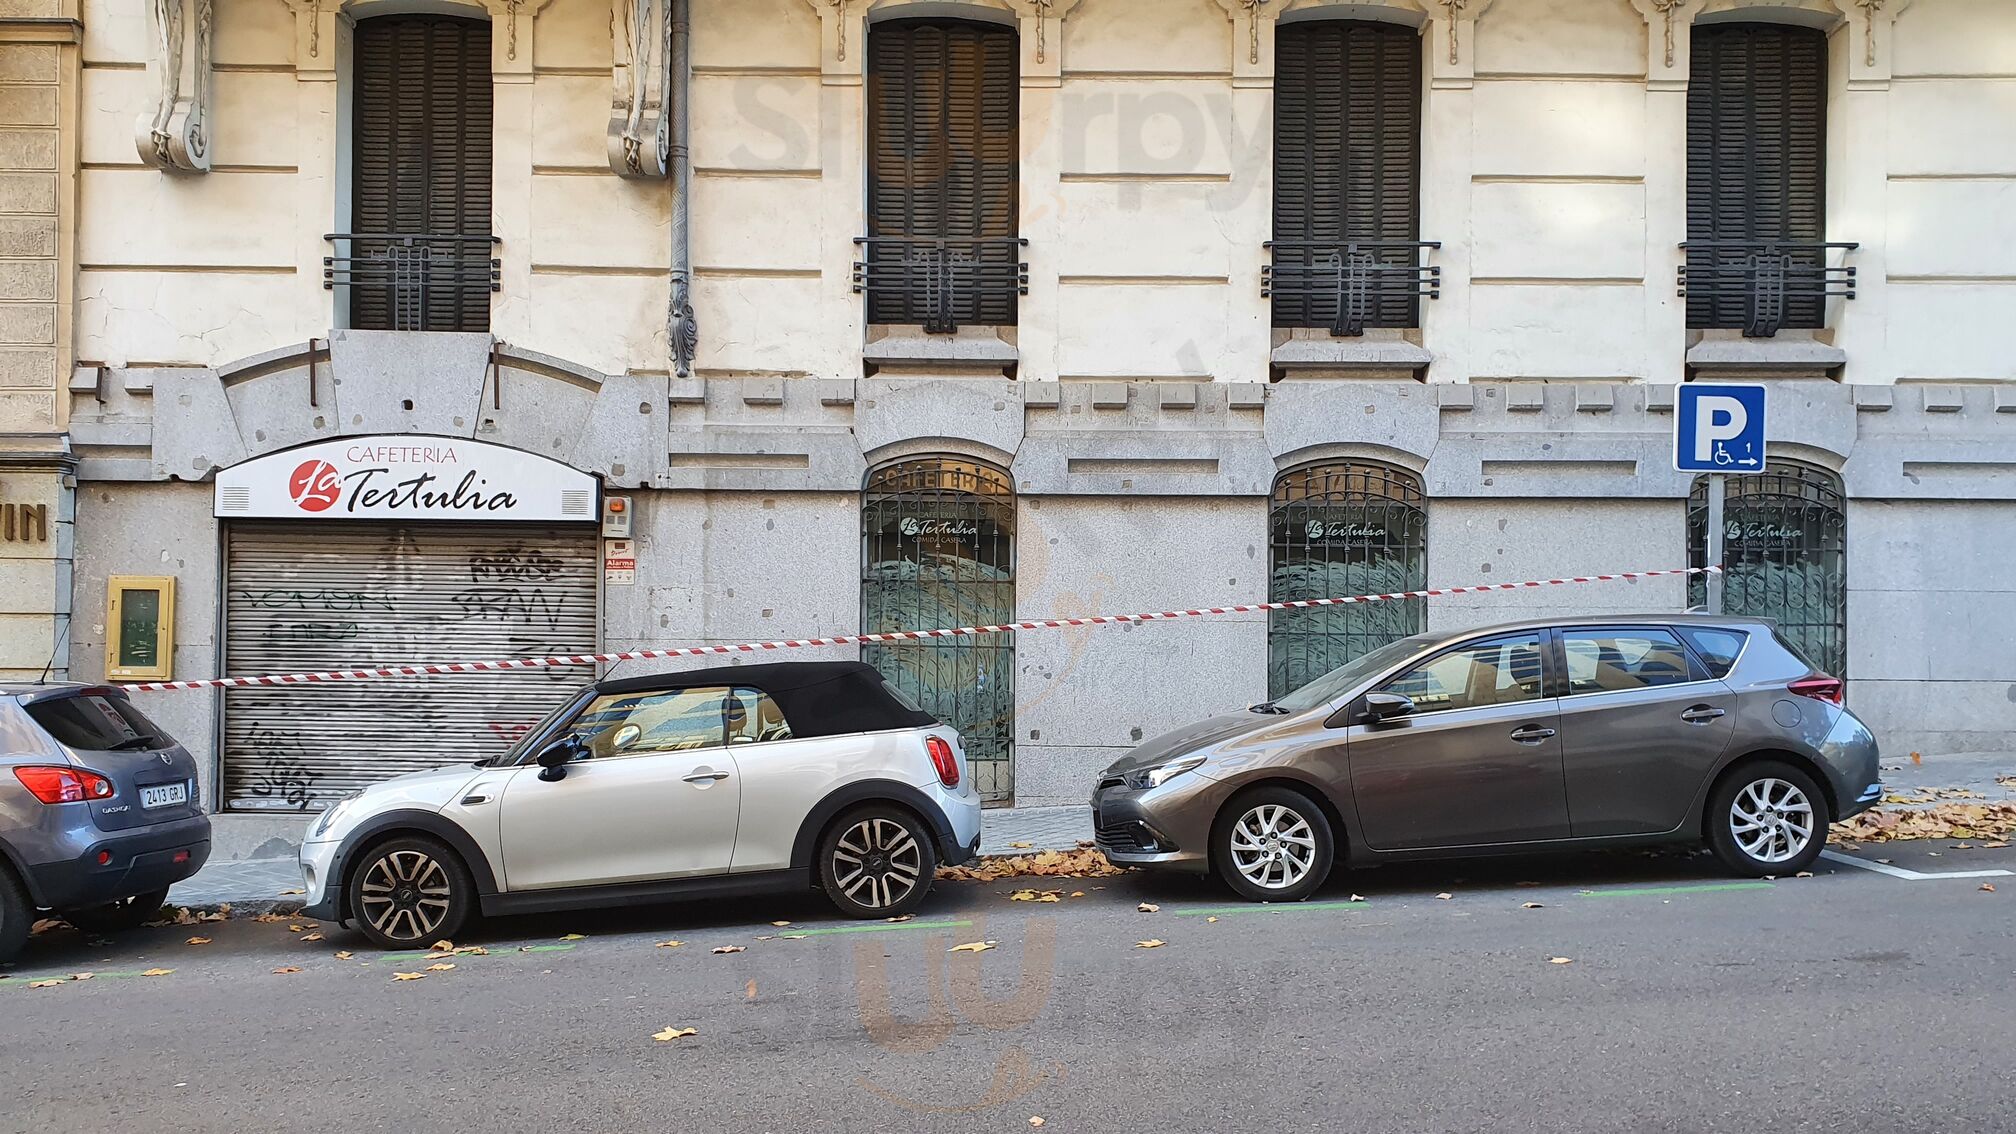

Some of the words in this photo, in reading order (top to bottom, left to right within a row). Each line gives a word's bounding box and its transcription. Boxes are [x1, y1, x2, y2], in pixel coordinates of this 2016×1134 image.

[1695, 395, 1748, 461] P
[346, 446, 458, 463] CAFETERIA
[1745, 442, 1751, 453] 1
[293, 459, 343, 504] La
[344, 467, 517, 512] Tertulia
[885, 468, 994, 492] CAFETERA
[920, 511, 958, 519] CAFEERIA
[920, 519, 977, 535] Tertulia
[1325, 521, 1386, 536] Tertulia
[146, 788, 167, 805] 2413
[169, 786, 184, 801] GRJ
